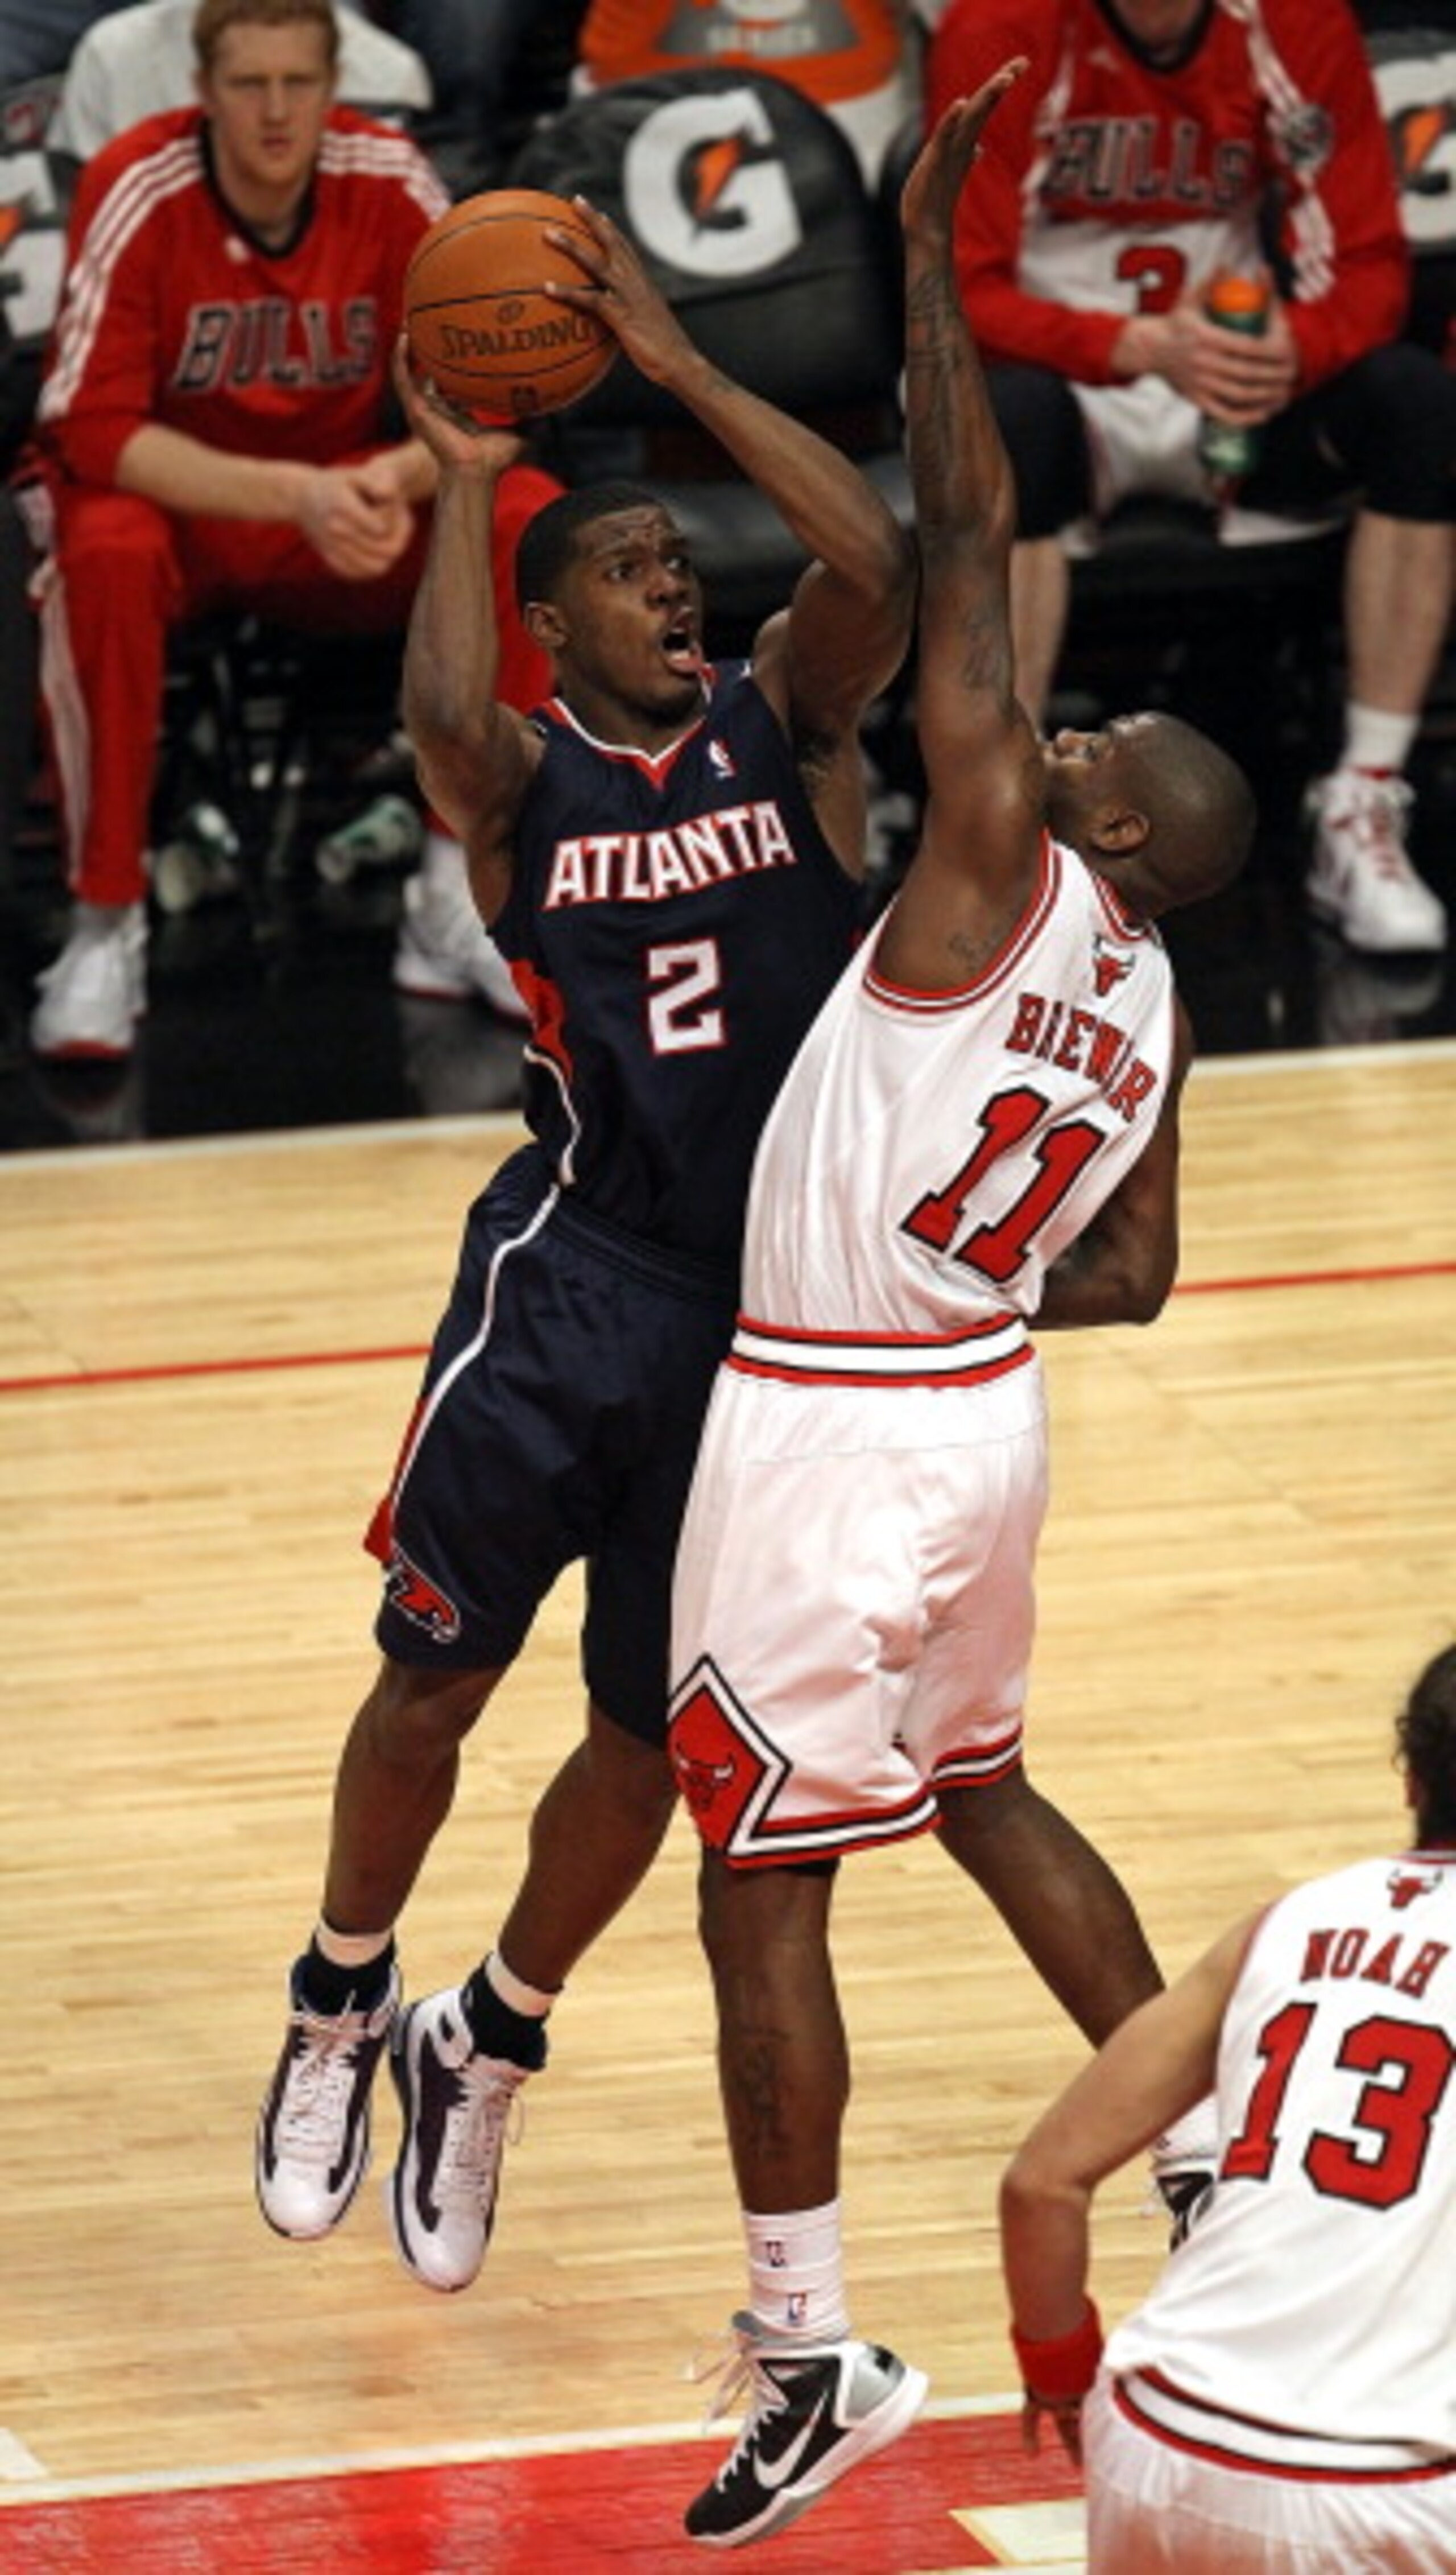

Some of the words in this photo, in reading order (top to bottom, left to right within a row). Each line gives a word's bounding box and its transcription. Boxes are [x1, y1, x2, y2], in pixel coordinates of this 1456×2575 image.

[624, 88, 803, 278] G
[173, 296, 377, 391] BULLS
[542, 800, 797, 910] ATLANTA
[647, 936, 727, 1057] 2
[1004, 992, 1158, 1123] BEWR
[900, 1083, 1108, 1282] 11
[1299, 1928, 1451, 1999] NOAH
[1218, 2001, 1456, 2212] 13
